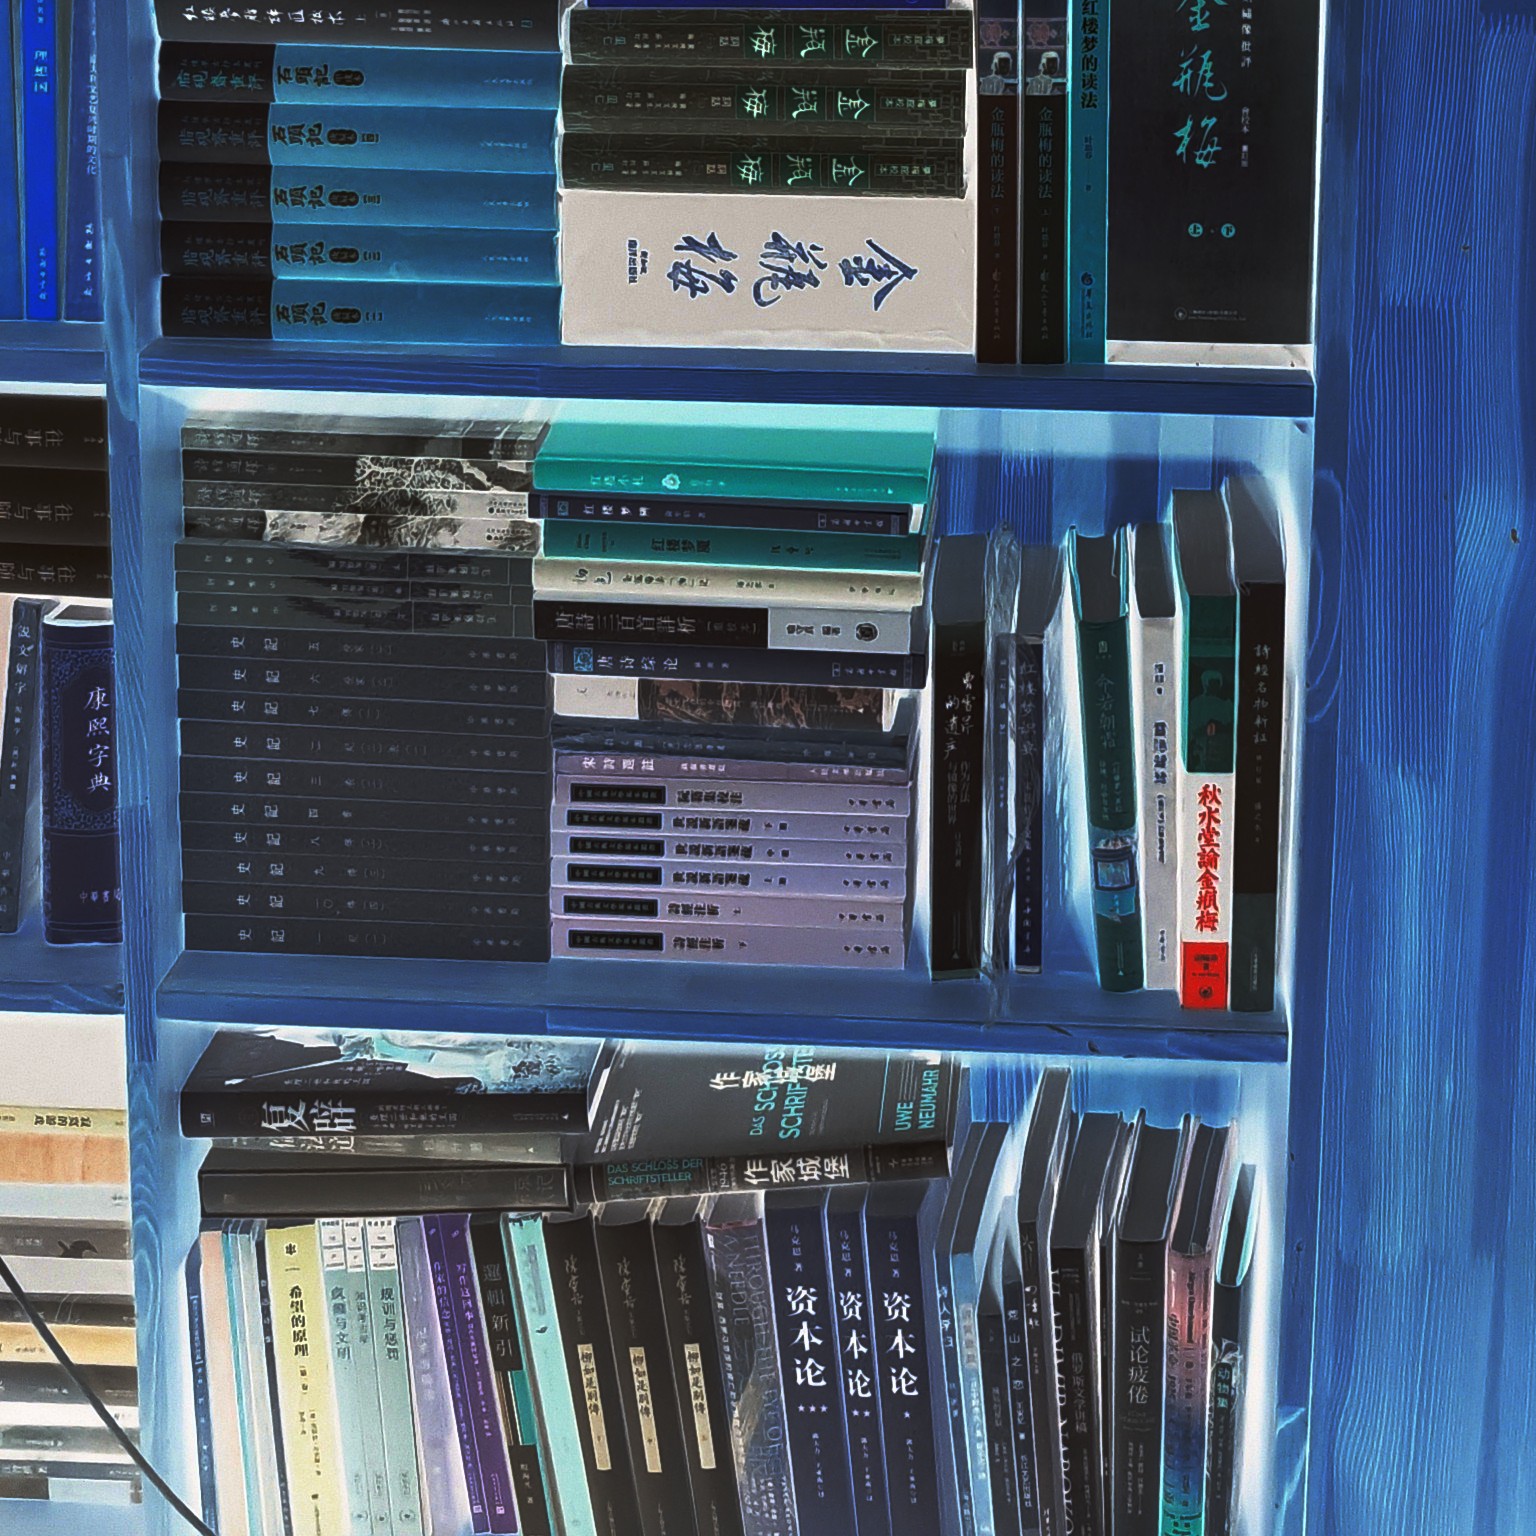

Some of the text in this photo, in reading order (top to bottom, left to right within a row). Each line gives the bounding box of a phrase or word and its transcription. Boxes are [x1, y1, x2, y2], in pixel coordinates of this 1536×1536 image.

[756, 25, 880, 58] 金瓶梅
[745, 86, 871, 119] 金瓶梅
[737, 154, 865, 186] 金瓶梅
[668, 232, 918, 311] 金瓶梅
[232, 634, 281, 659] 史記
[235, 665, 284, 690] 史記
[232, 697, 281, 722] 史記
[235, 732, 284, 757] 史記
[236, 767, 285, 792] 史記
[233, 799, 282, 824] 史記
[236, 830, 285, 855] 史記
[1197, 783, 1222, 933] 秋水堂論金瓶梅
[239, 860, 288, 885] 史記
[239, 891, 288, 916] 史記
[240, 926, 289, 951] 史記
[918, 1068, 942, 1130] NEUMAHR
[894, 1099, 915, 1132] UWE
[608, 1155, 706, 1174] DAS SCHLOSS DER
[609, 1170, 695, 1187] SCHRIFTSTELLER
[745, 1152, 853, 1187] 作家城堡
[289, 1284, 310, 1358] 希望的原理
[380, 1286, 400, 1361] 规训与惩罚
[785, 1286, 830, 1390] 资本论
[839, 1290, 874, 1399] 资本论
[883, 1291, 921, 1397] 资本论
